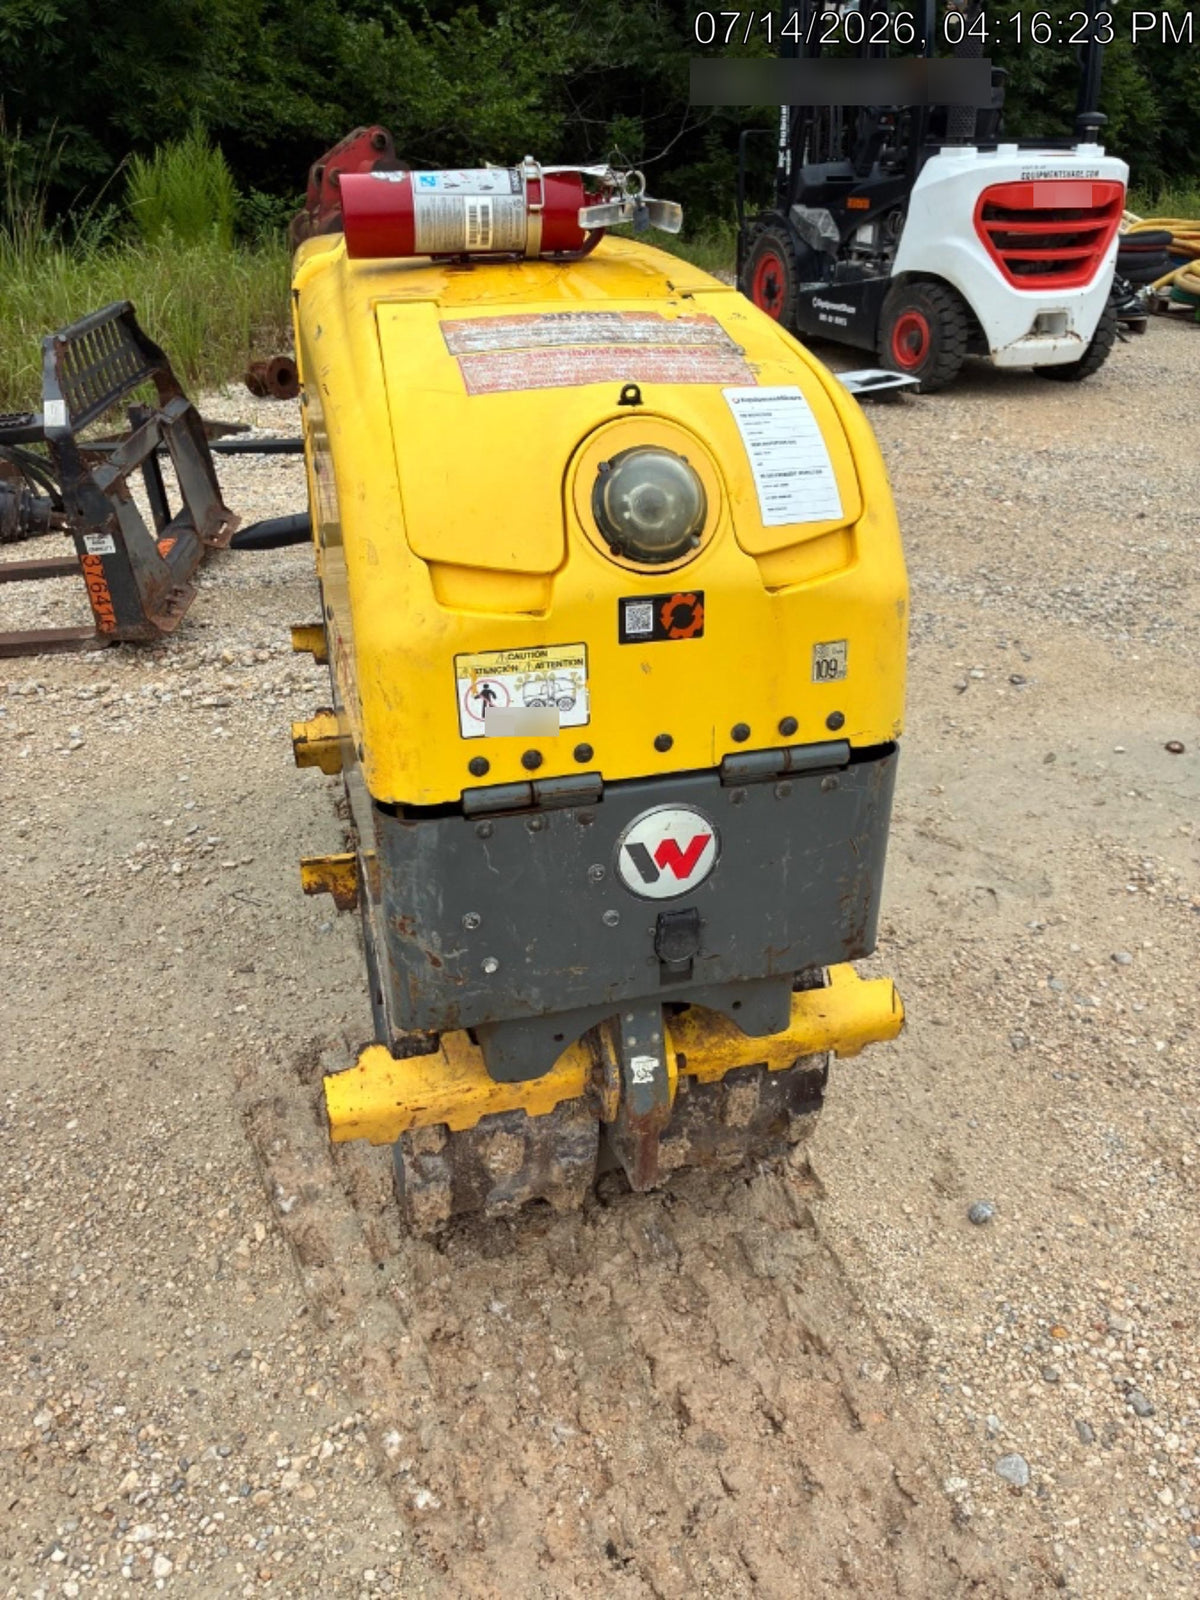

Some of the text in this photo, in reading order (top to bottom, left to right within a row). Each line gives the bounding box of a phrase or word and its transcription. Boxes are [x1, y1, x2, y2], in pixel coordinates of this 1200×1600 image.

[507, 650, 548, 661] CAUTION
[534, 658, 583, 669] ATTENTION
[815, 659, 838, 679] 109
